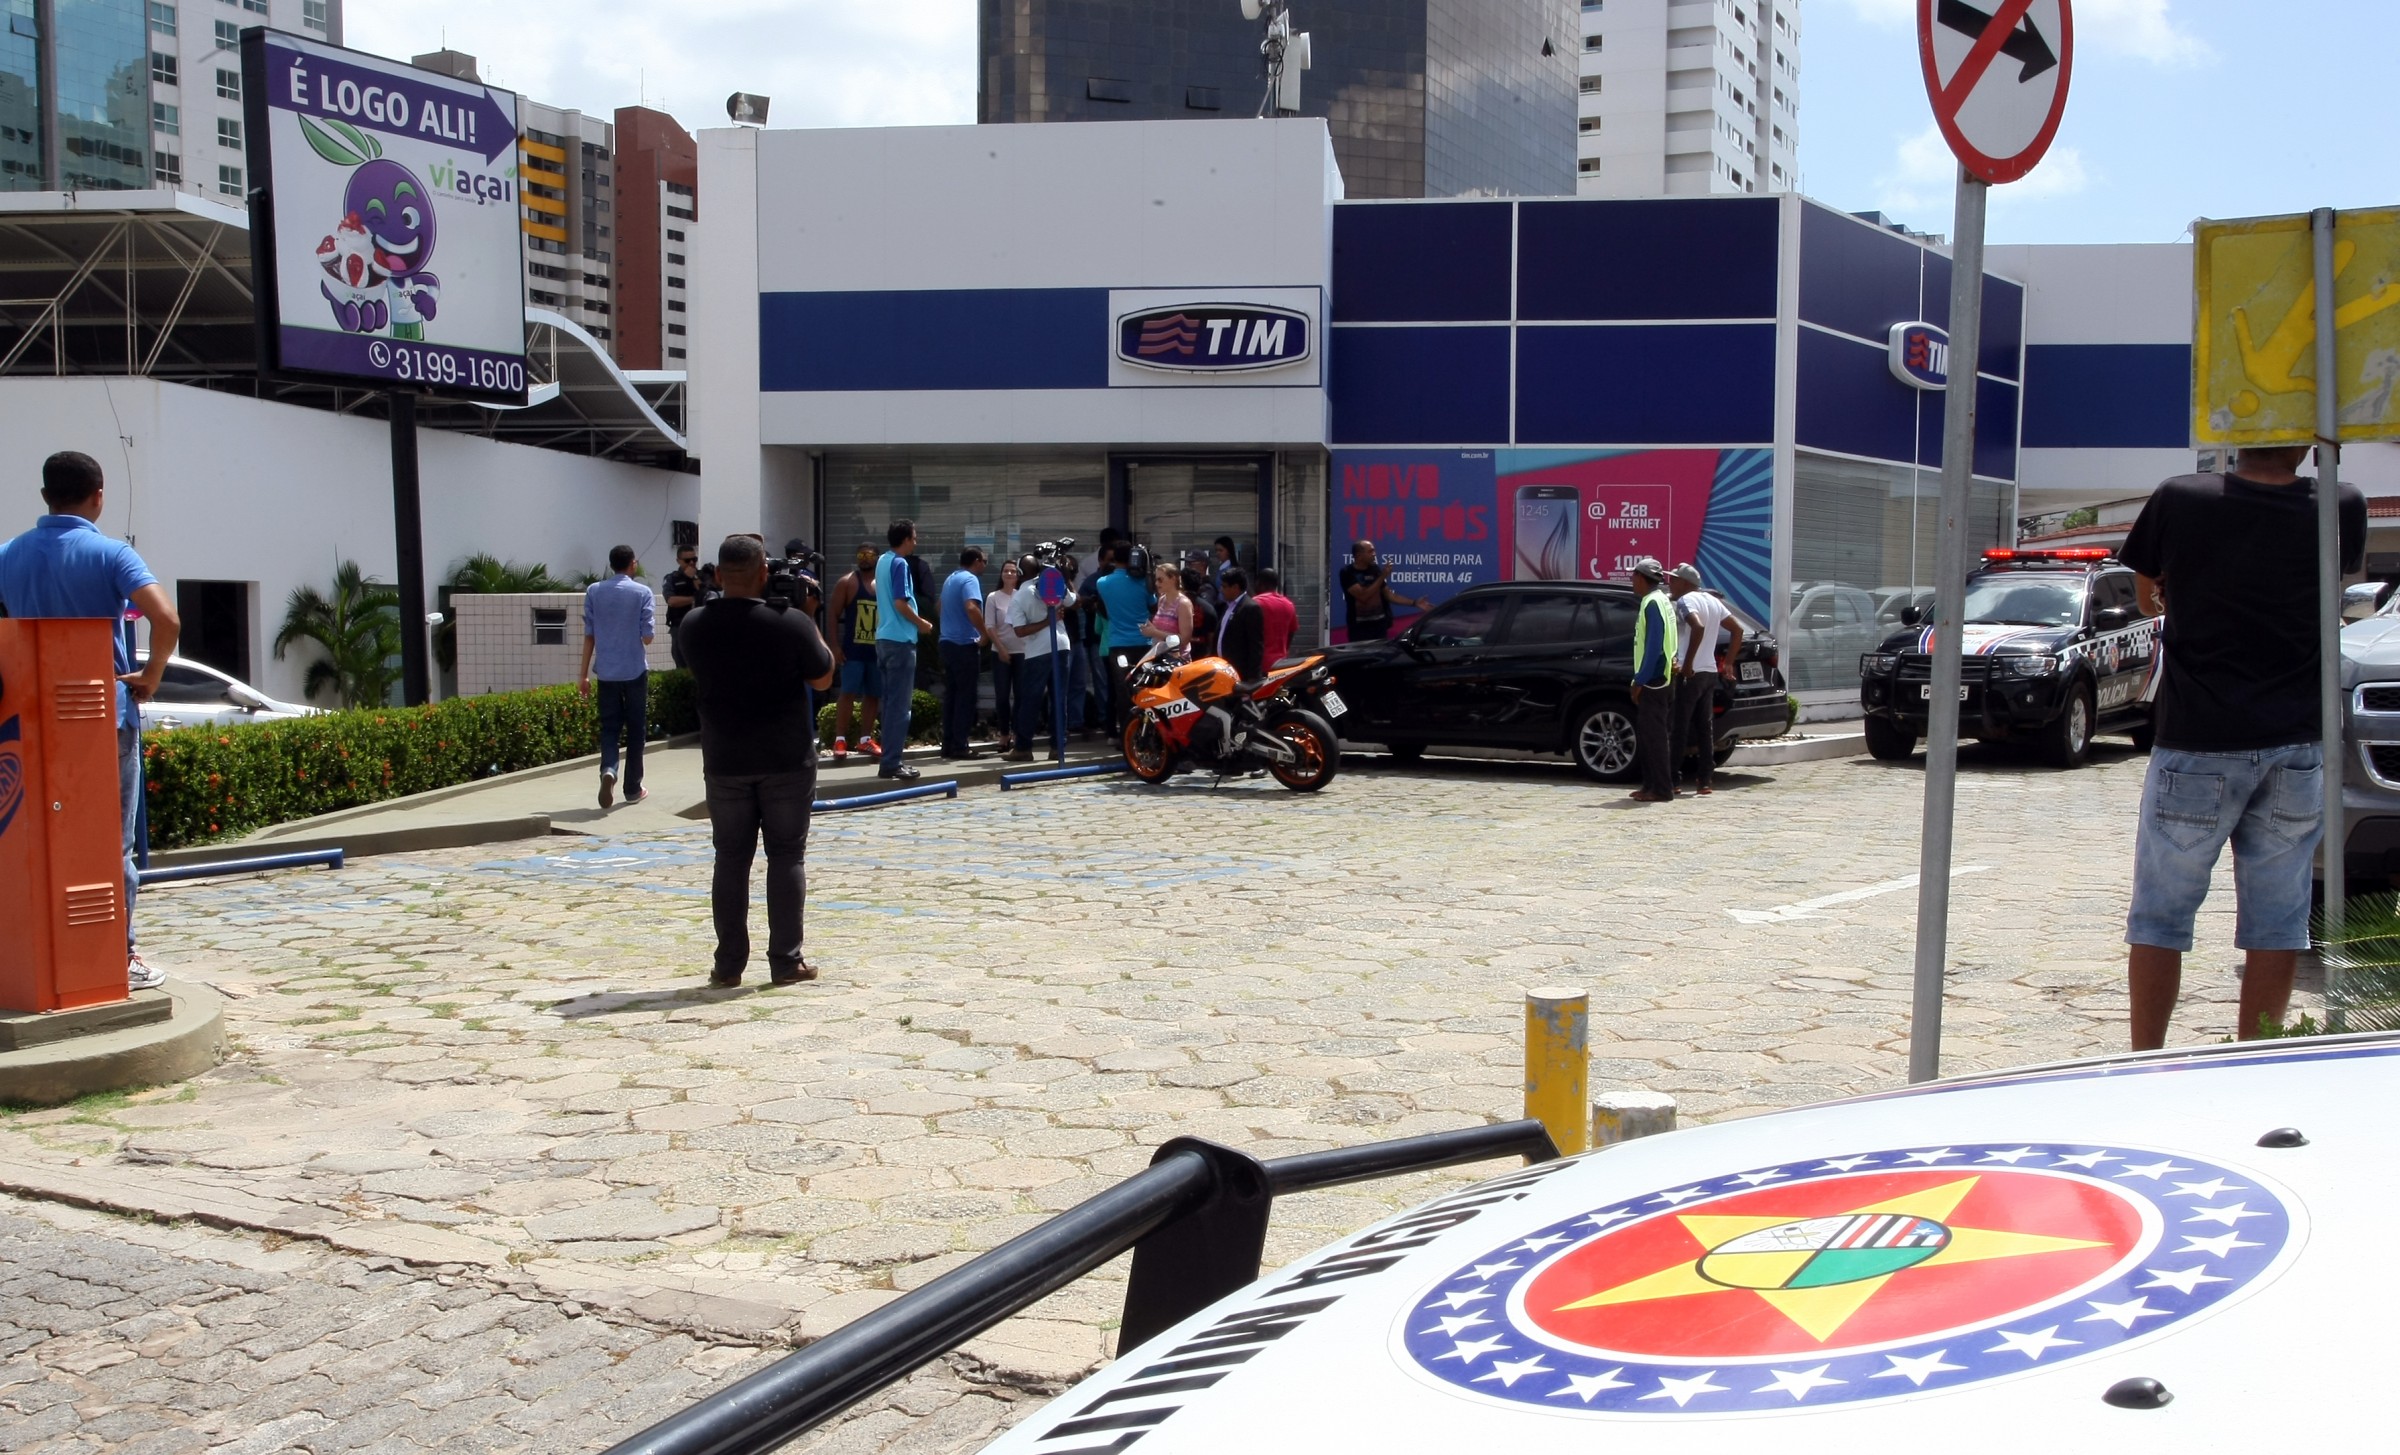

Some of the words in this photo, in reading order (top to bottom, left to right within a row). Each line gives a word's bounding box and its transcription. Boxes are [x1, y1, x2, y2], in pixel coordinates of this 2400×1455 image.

[289, 57, 308, 105] É
[321, 74, 409, 127] LOGO
[419, 100, 477, 144] ALI!
[1206, 319, 1287, 356] TIM
[395, 348, 523, 392] 3199-1600
[1343, 463, 1440, 499] NOVO
[1343, 505, 1405, 541] TIM
[1419, 499, 1488, 541] PÓS
[1520, 504, 1549, 517] 12:45
[1620, 501, 1648, 517] 2GB
[1608, 518, 1661, 529] INTERNET
[1405, 552, 1449, 565] NÚMERO
[1453, 554, 1482, 565] PARA
[1391, 572, 1454, 583] COBERTURA
[1457, 572, 1472, 583] 4G
